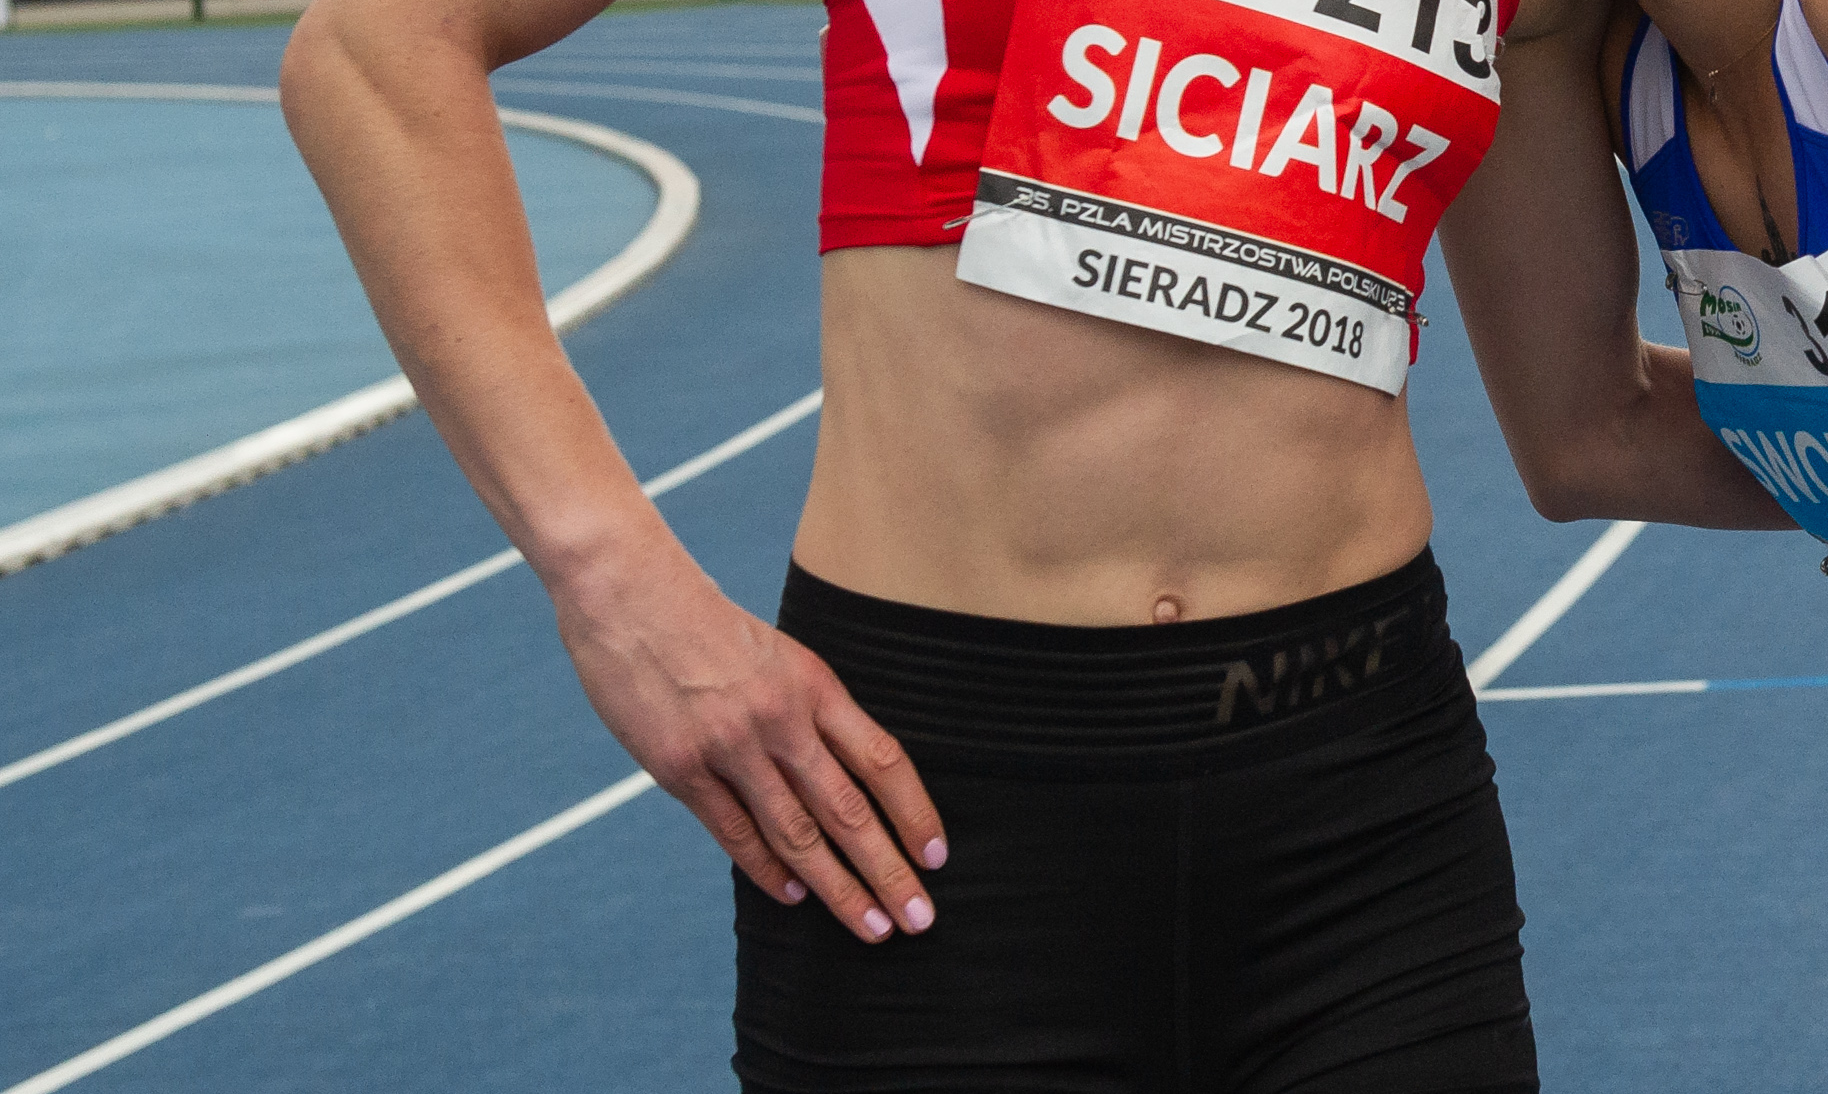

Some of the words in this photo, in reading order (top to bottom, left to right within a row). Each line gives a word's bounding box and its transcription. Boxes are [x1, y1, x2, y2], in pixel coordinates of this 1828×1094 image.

[1046, 24, 1450, 224] SICIARZ
[1060, 198, 1133, 232] PZLA
[1138, 216, 1323, 283] MISTRZOSTWA
[1327, 267, 1380, 302] POLSKI
[1072, 248, 1280, 334] SIERADZ
[1281, 302, 1364, 359] 2018
[1216, 609, 1408, 725] NIKE
